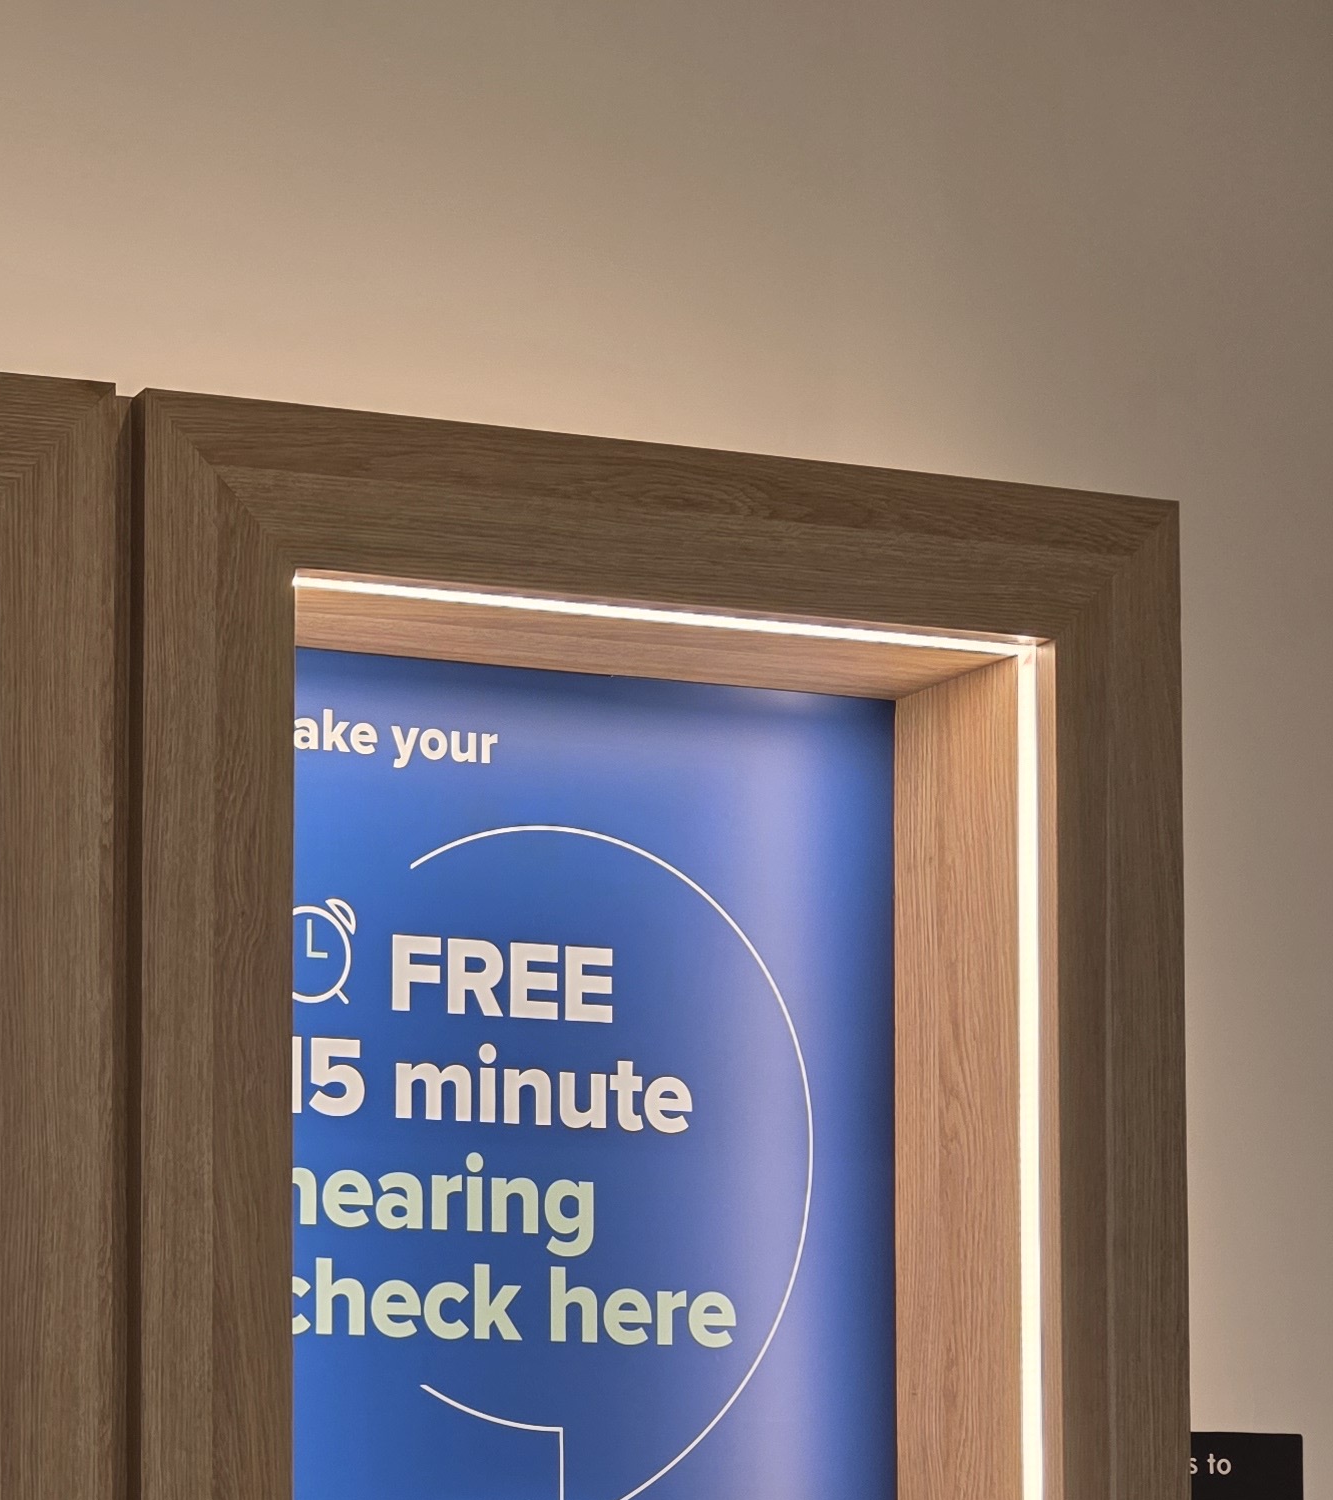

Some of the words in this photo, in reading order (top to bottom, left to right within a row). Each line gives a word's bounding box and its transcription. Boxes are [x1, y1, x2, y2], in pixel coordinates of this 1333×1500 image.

[294, 708, 378, 755] ake
[391, 725, 499, 769] your
[391, 933, 614, 1024] FREE
[395, 1042, 693, 1133] minute
[549, 1266, 737, 1348] here
[1206, 1453, 1232, 1475] to
